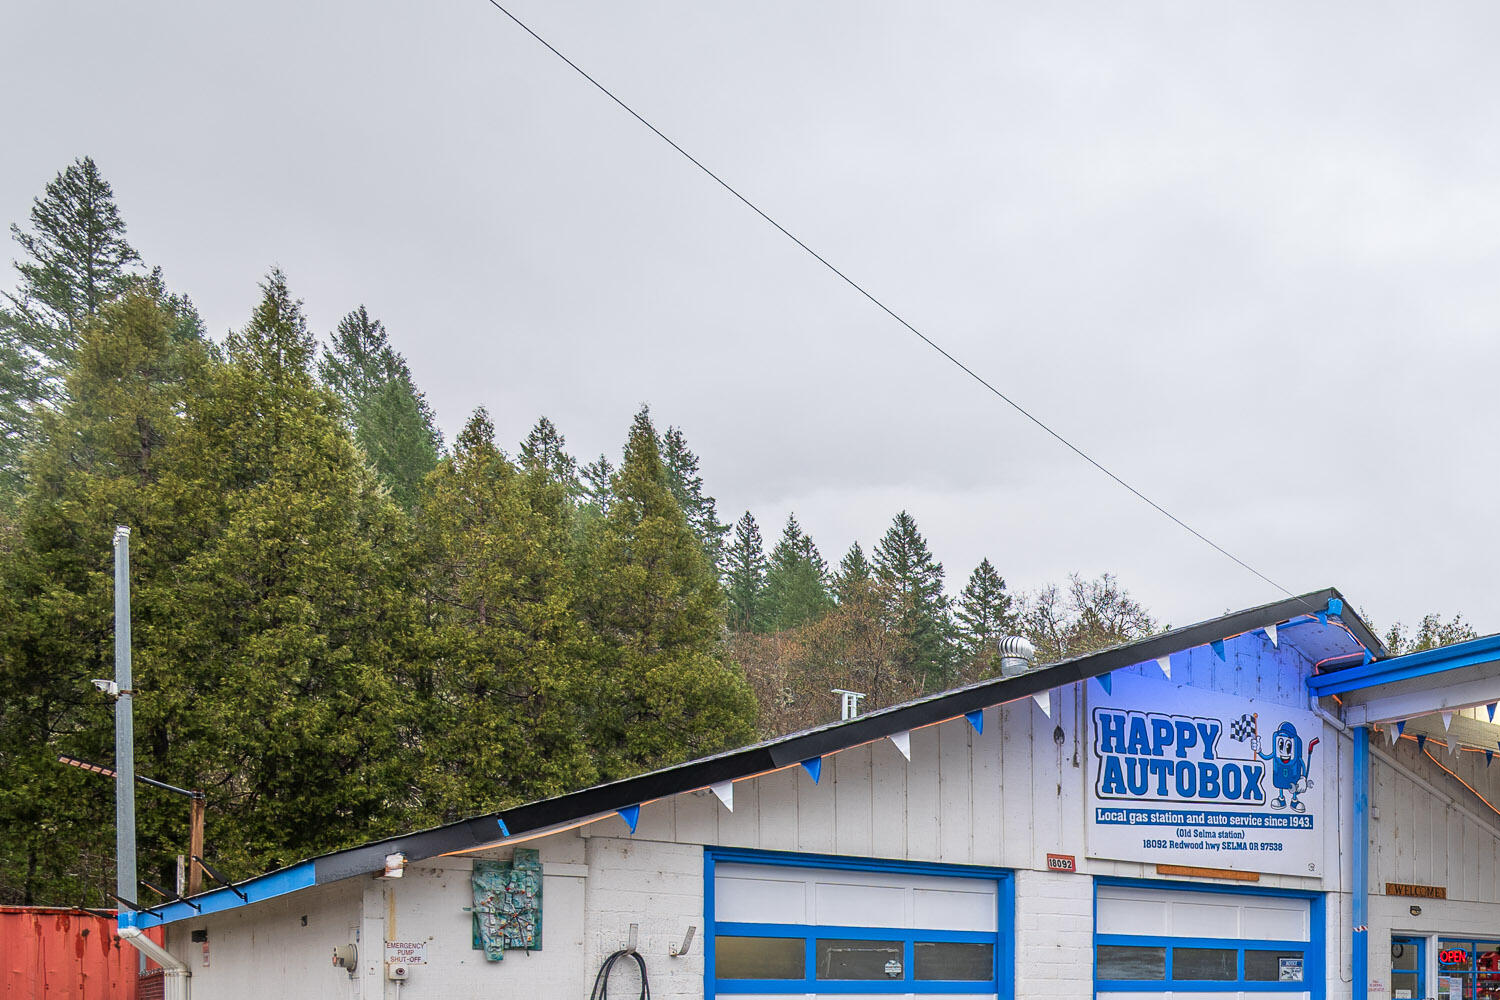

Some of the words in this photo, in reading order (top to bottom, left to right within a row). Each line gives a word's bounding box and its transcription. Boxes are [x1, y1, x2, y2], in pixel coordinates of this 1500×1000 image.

[1099, 713, 1220, 760] HAPPY
[1101, 756, 1263, 800] AUTOBOX
[1097, 808, 1127, 822] Local
[1129, 812, 1148, 825] gas
[1150, 811, 1185, 825] station
[1187, 812, 1205, 825] and
[1207, 814, 1227, 826] auto
[1229, 815, 1262, 827] service
[1264, 815, 1288, 827] since
[1289, 816, 1313, 828] 1943.
[1176, 828, 1191, 839] (Old
[1193, 829, 1216, 839] Selma
[1217, 829, 1245, 840] station)
[1143, 839, 1167, 849] 18092
[1169, 840, 1204, 850] Redwood
[1205, 841, 1220, 852] hwy
[1221, 842, 1247, 851] SELMA
[1249, 842, 1259, 851] OR
[1260, 842, 1283, 852] 97538
[1049, 858, 1073, 869] 18092
[1394, 884, 1441, 898] WELCOME
[1439, 950, 1466, 962] OPEN
